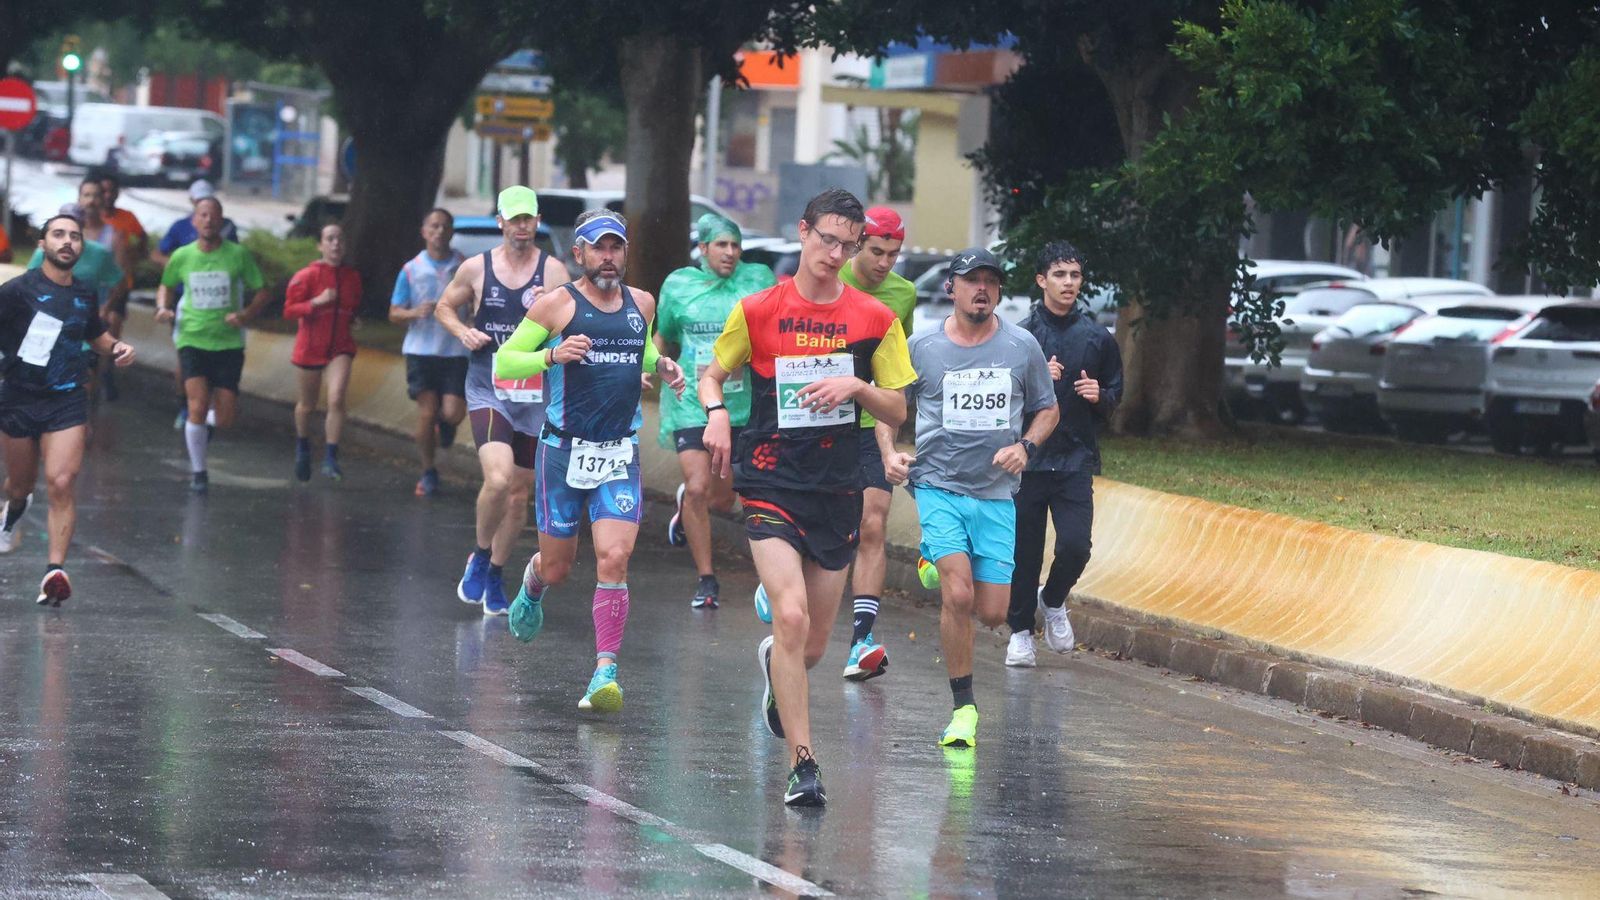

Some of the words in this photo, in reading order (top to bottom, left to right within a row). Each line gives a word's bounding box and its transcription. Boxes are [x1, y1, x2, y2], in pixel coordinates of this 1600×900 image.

[778, 316, 848, 339] Málaga
[795, 332, 847, 349] Bahía
[950, 392, 1007, 410] 12958
